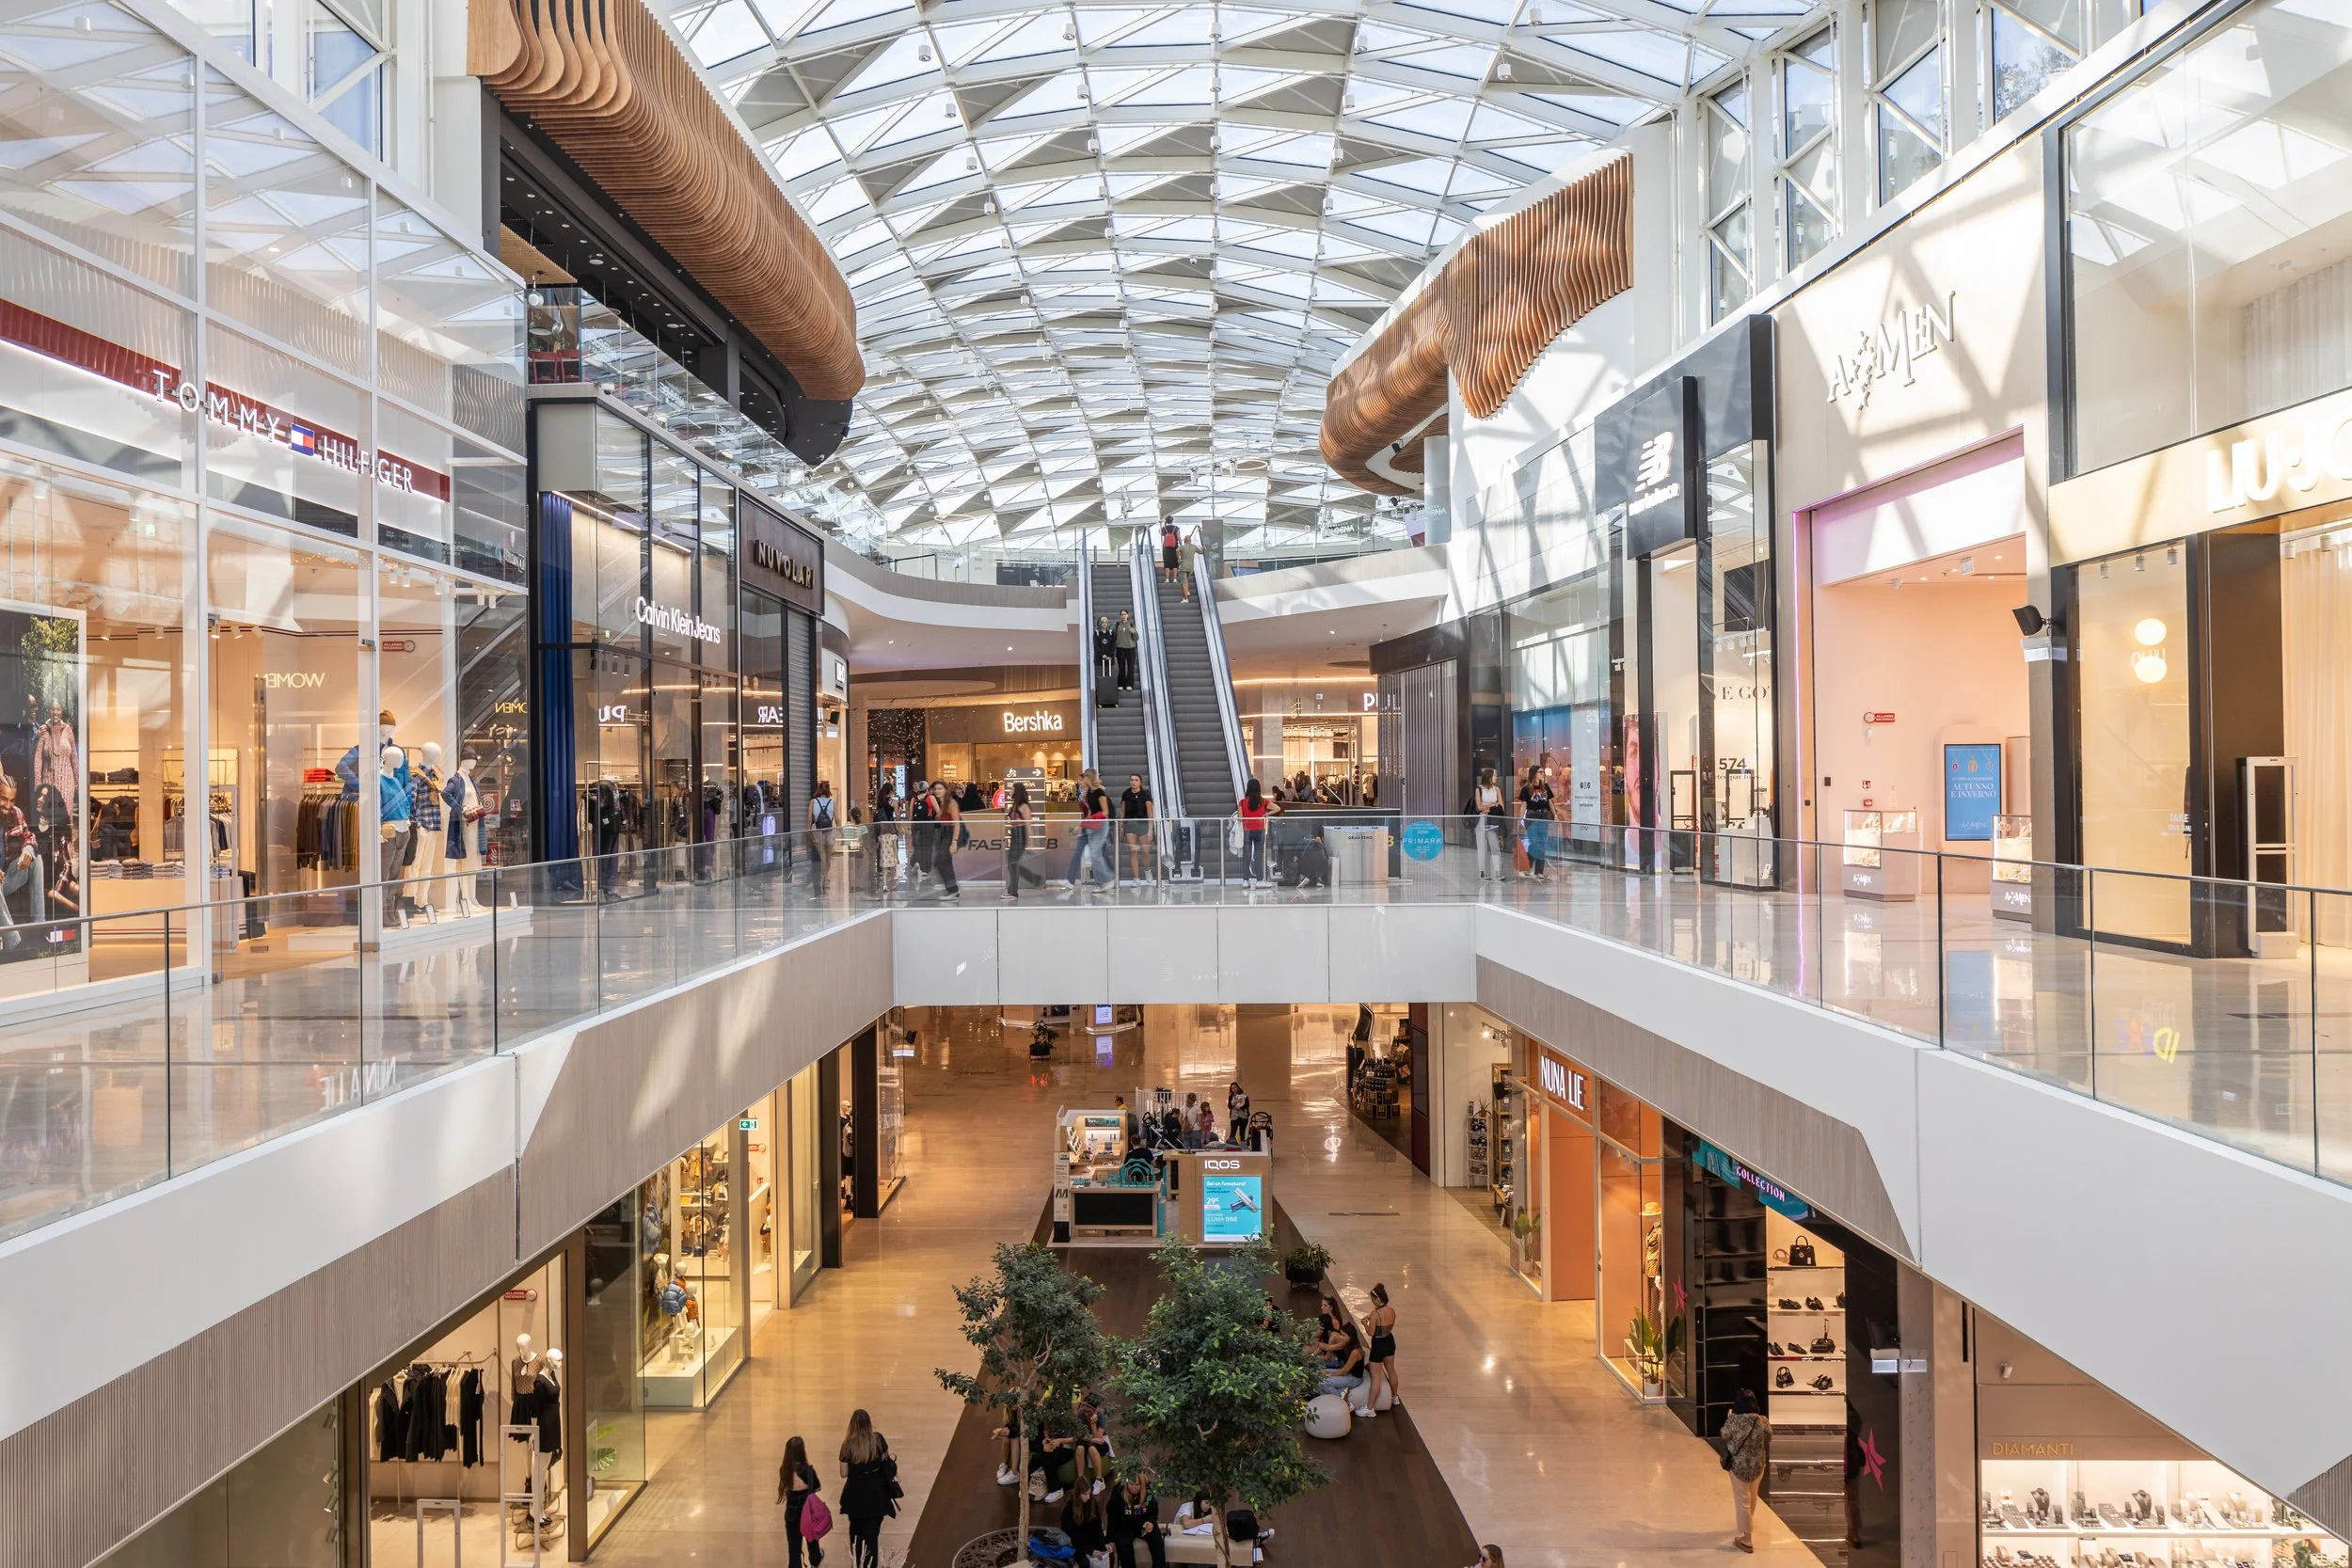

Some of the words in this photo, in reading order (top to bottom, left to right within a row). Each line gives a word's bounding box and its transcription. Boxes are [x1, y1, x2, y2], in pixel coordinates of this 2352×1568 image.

[151, 369, 280, 442] TOMMY
[321, 435, 412, 493] HILFIGER
[758, 543, 816, 588] NUVOLARI
[636, 596, 670, 630] Calvin
[671, 607, 694, 638] Klein
[694, 615, 721, 644] Jeans
[1003, 710, 1063, 733] Bershka
[1719, 758, 1747, 770] 574
[1952, 783, 1994, 791] AUTUNNO
[1957, 790, 1996, 799] INVERNO
[967, 838, 1058, 851] FASB
[1541, 1055, 1566, 1101] NUNA
[1568, 1070, 1584, 1111] LIE
[1204, 1160, 1240, 1170] IQOS
[1736, 1165, 1786, 1203] COLLECTION
[1992, 1442, 2074, 1456] DIAMANTI
